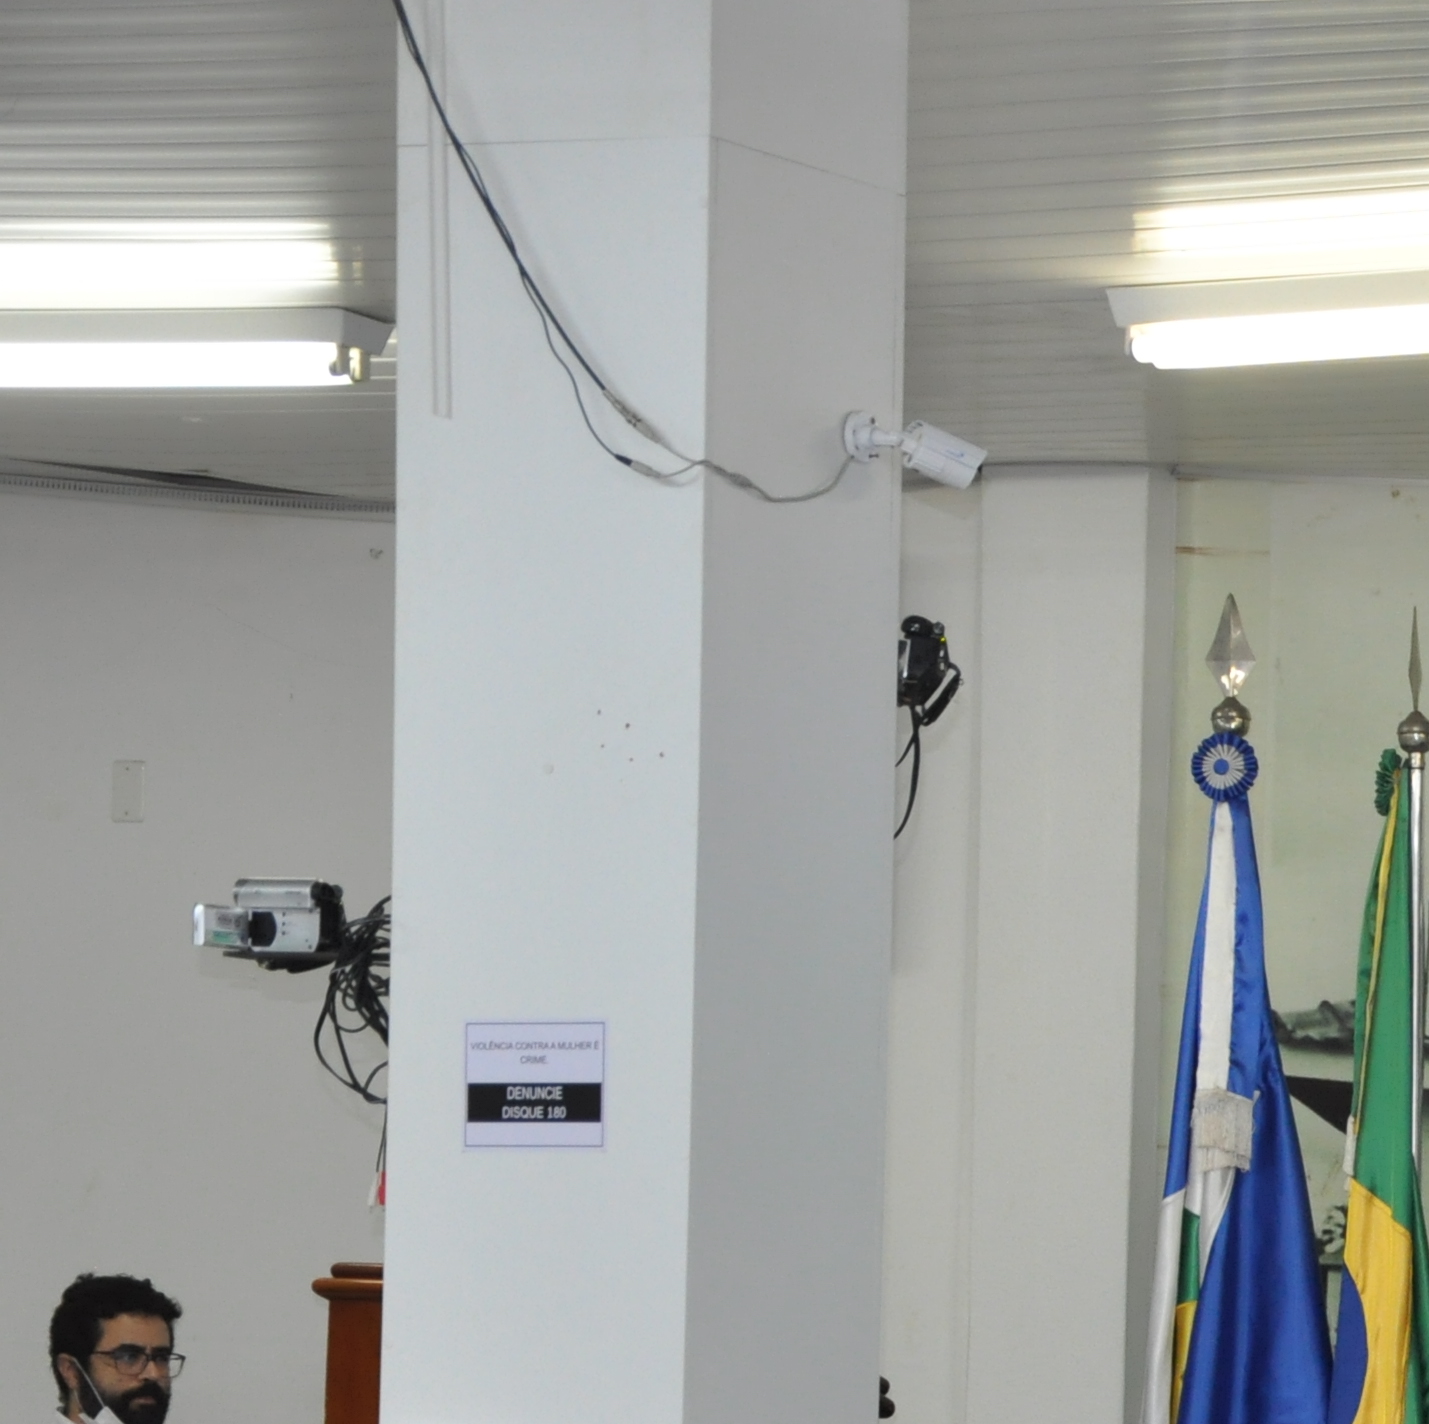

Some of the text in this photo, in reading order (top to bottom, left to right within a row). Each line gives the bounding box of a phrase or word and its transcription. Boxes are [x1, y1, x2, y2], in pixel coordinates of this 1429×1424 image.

[507, 1086, 563, 1100] DENUNCIE
[502, 1106, 567, 1119] DISQUE 180
